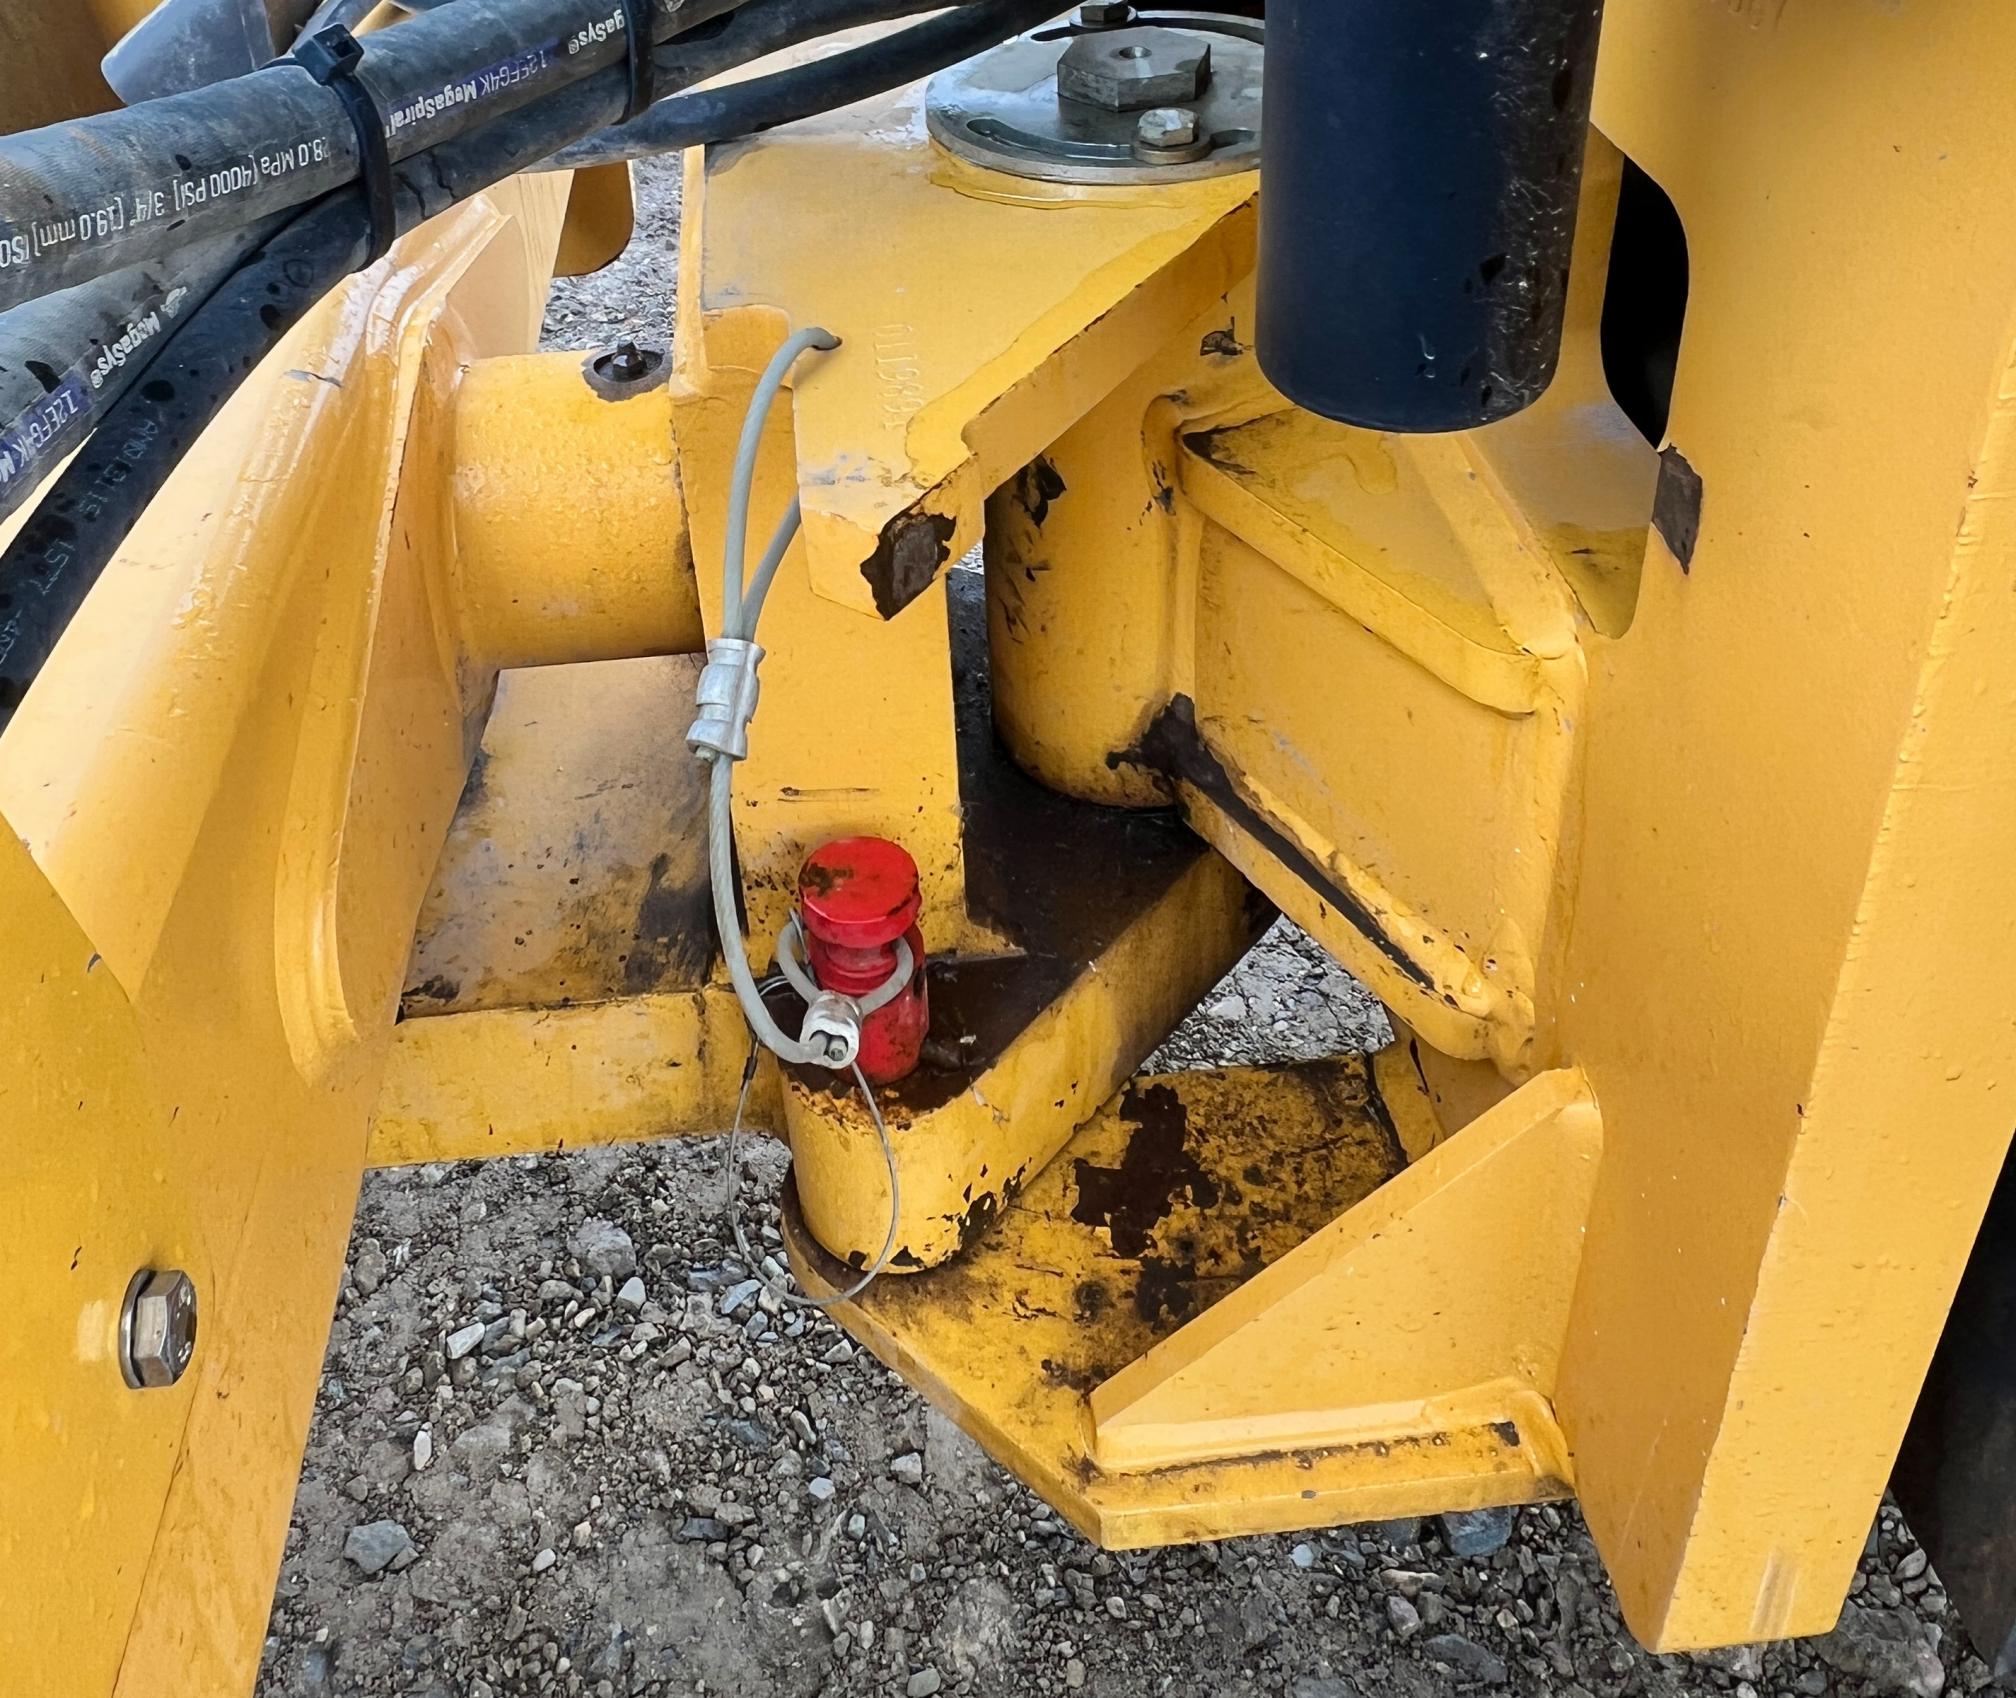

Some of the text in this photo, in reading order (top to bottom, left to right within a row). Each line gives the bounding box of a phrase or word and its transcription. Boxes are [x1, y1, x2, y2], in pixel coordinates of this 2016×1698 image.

[210, 154, 258, 198] [4000
[260, 147, 295, 177] MPa
[173, 178, 207, 211] PSI]
[31, 217, 76, 257] mm]
[80, 197, 124, 240] [19.0
